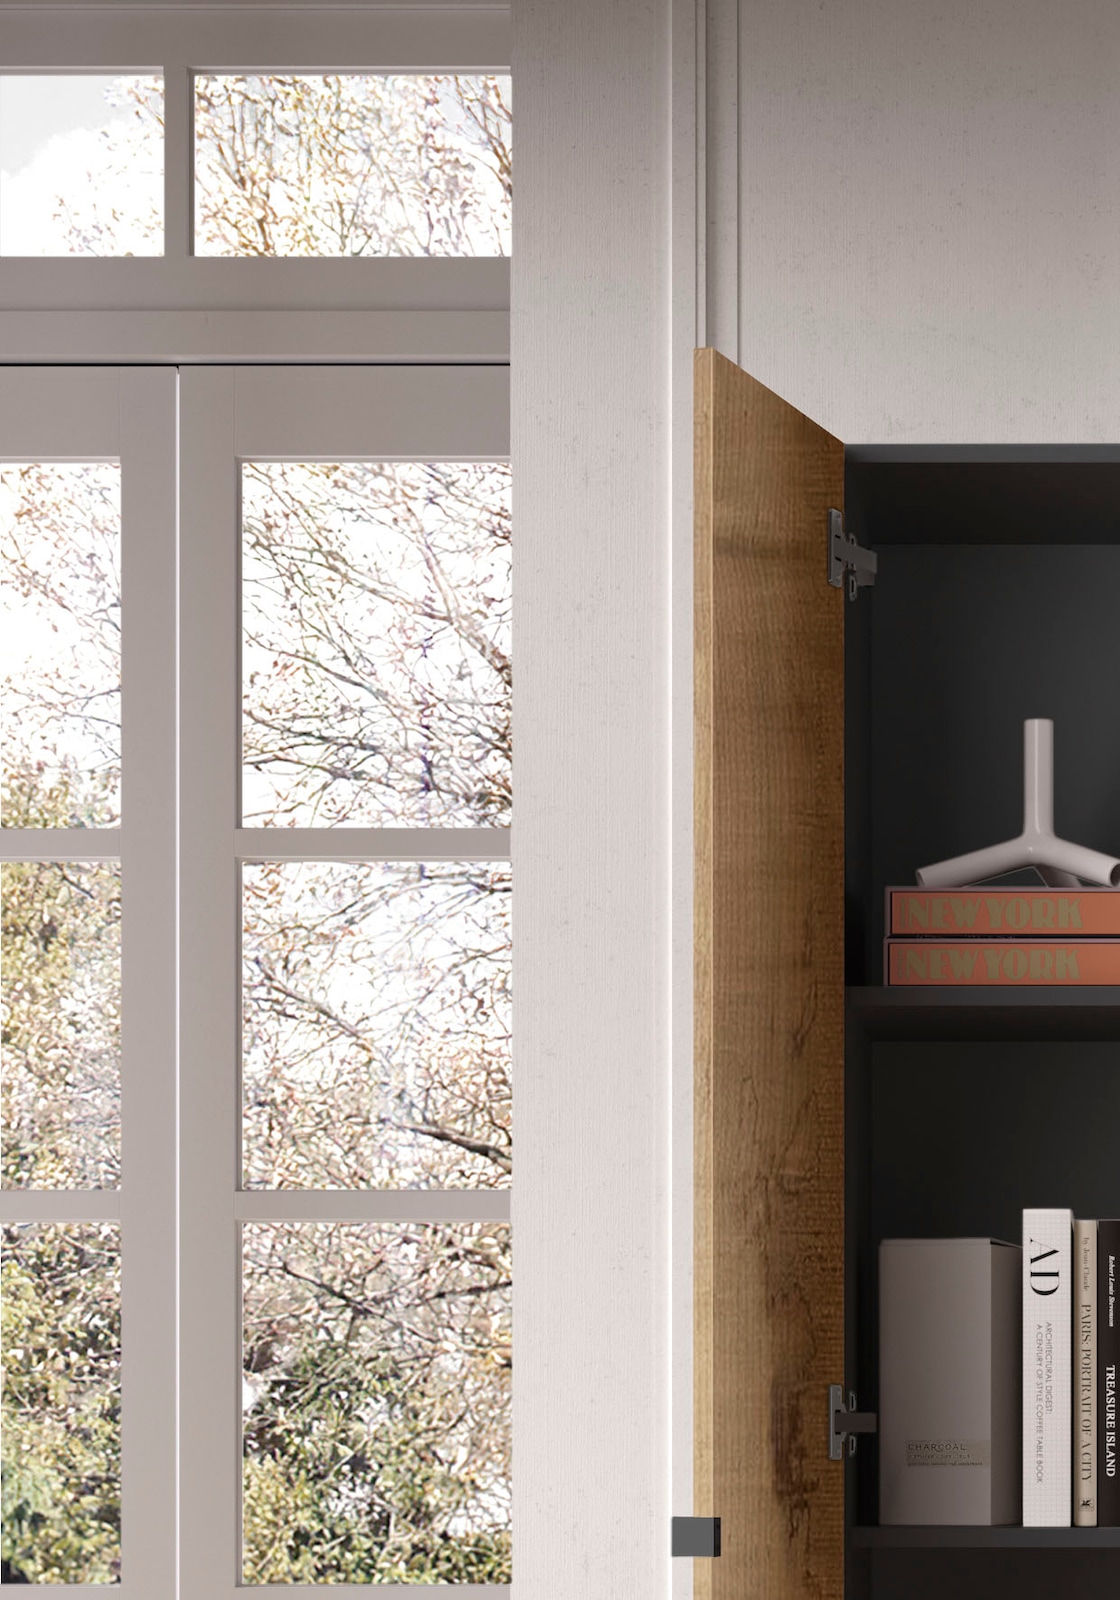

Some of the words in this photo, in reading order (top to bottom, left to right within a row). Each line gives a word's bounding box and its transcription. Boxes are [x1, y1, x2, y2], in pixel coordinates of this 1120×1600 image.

[1030, 1238, 1061, 1296] AD
[1108, 1254, 1116, 1277] Robert
[1108, 1277, 1116, 1295] Louis
[1081, 1304, 1092, 1345] PARIS:
[1108, 1296, 1116, 1327] Stevenson
[1036, 1332, 1044, 1366] CENTURY
[1045, 1322, 1053, 1383] ARCHITECTURAL
[1036, 1369, 1044, 1380] OF
[1081, 1349, 1092, 1417] PORTRAIT
[1036, 1382, 1044, 1402] STYLE
[1045, 1385, 1053, 1415] DIGEST:
[1105, 1365, 1116, 1429] TREASURE
[1036, 1404, 1044, 1434] COFFEE
[1081, 1419, 1092, 1436] OF
[907, 1443, 966, 1452] CHARCOAL
[1036, 1436, 1044, 1458] TABLE
[1081, 1440, 1092, 1449] A
[1105, 1431, 1116, 1477] ISLAND
[1036, 1460, 1044, 1483] BOOK
[1081, 1452, 1092, 1483] CITY
